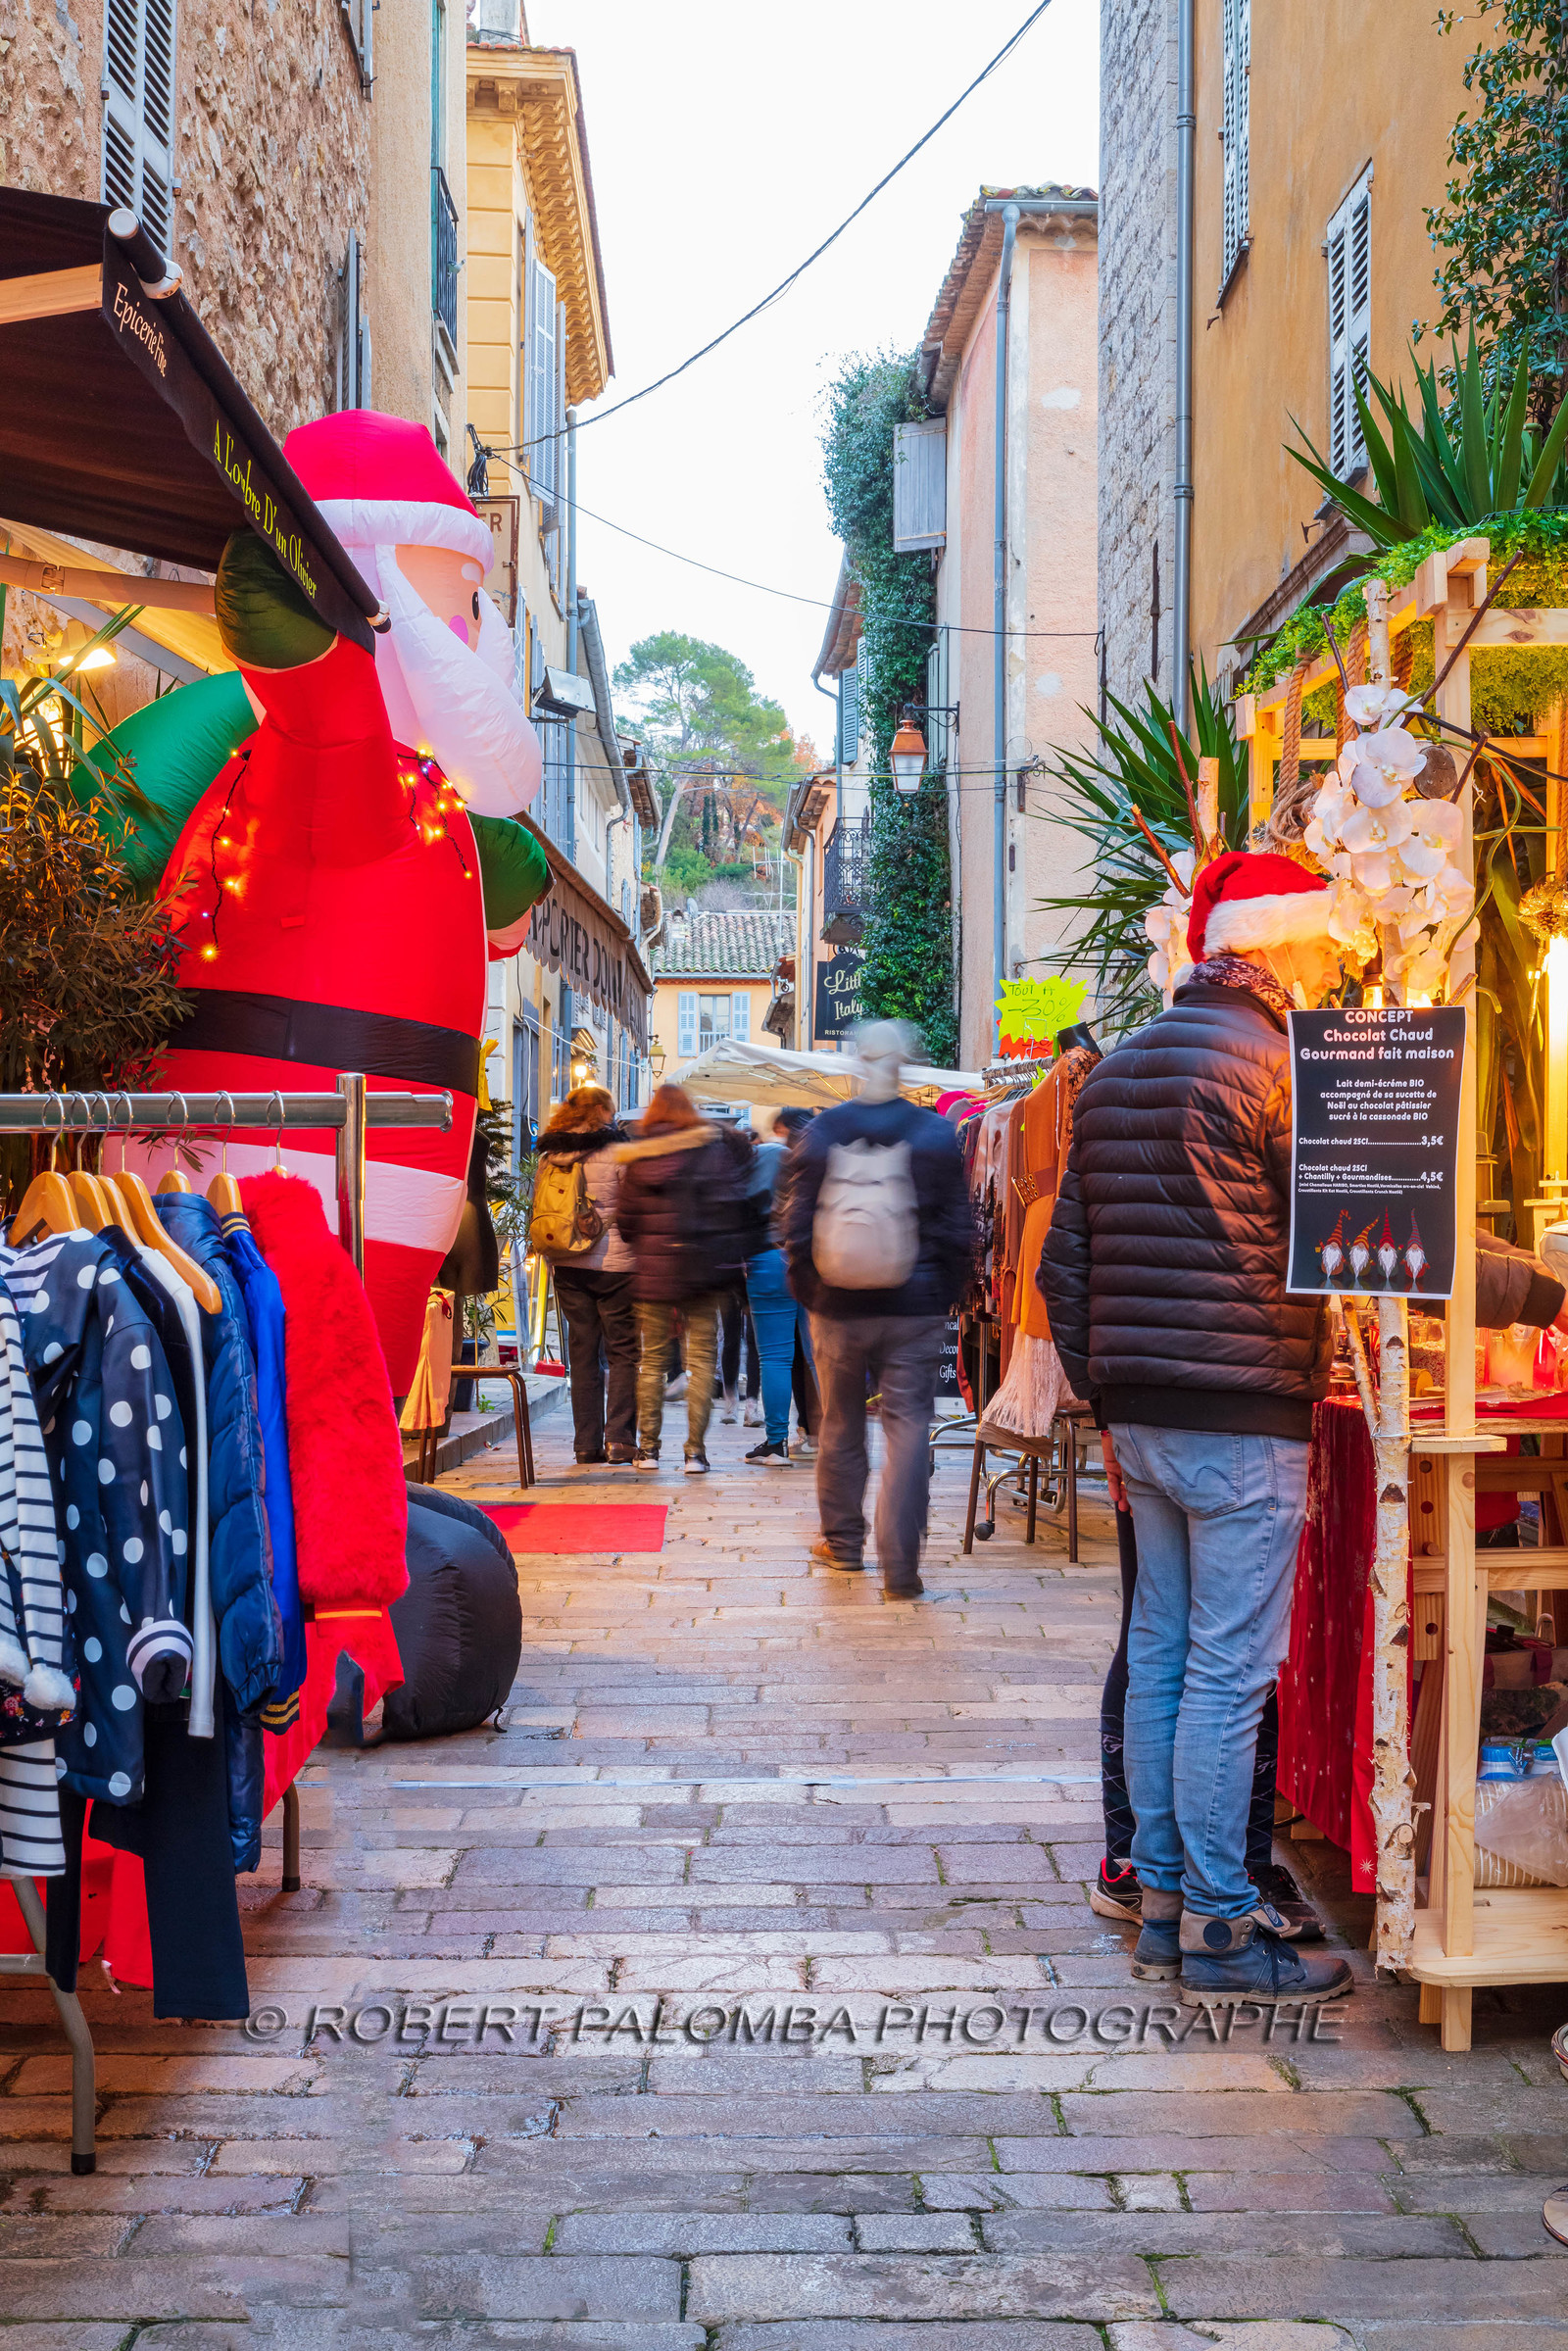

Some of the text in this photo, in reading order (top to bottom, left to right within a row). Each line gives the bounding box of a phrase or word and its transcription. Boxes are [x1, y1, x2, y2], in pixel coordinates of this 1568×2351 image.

[114, 281, 157, 355] Epicerie
[214, 418, 222, 465] A
[289, 534, 317, 600] Olivier
[824, 969, 862, 996] Littl
[1007, 983, 1036, 997] TOUT
[1007, 997, 1073, 1023] -30%
[1345, 1009, 1414, 1024] CONCEPT
[1323, 1027, 1434, 1043] Chocolat Chaud
[1299, 1046, 1455, 1060] Gourmand fait maison
[1336, 1079, 1353, 1088] Lait
[1409, 1079, 1425, 1088] BIO
[1320, 1090, 1371, 1102] accompagné
[1372, 1090, 1383, 1099] de
[1427, 1090, 1437, 1099] de
[1327, 1101, 1347, 1110] Noël
[1359, 1101, 1395, 1110] chocolat
[1396, 1101, 1432, 1111] pâtissier
[1329, 1111, 1429, 1121] sucré à la cassonade BIO
[1298, 1137, 1330, 1146] Chocolat
[1330, 1137, 1352, 1146] chaud
[1298, 1163, 1329, 1172] Chocolat
[1303, 1172, 1335, 1183] Chantilly
[939, 1363, 956, 1383] Gifts
